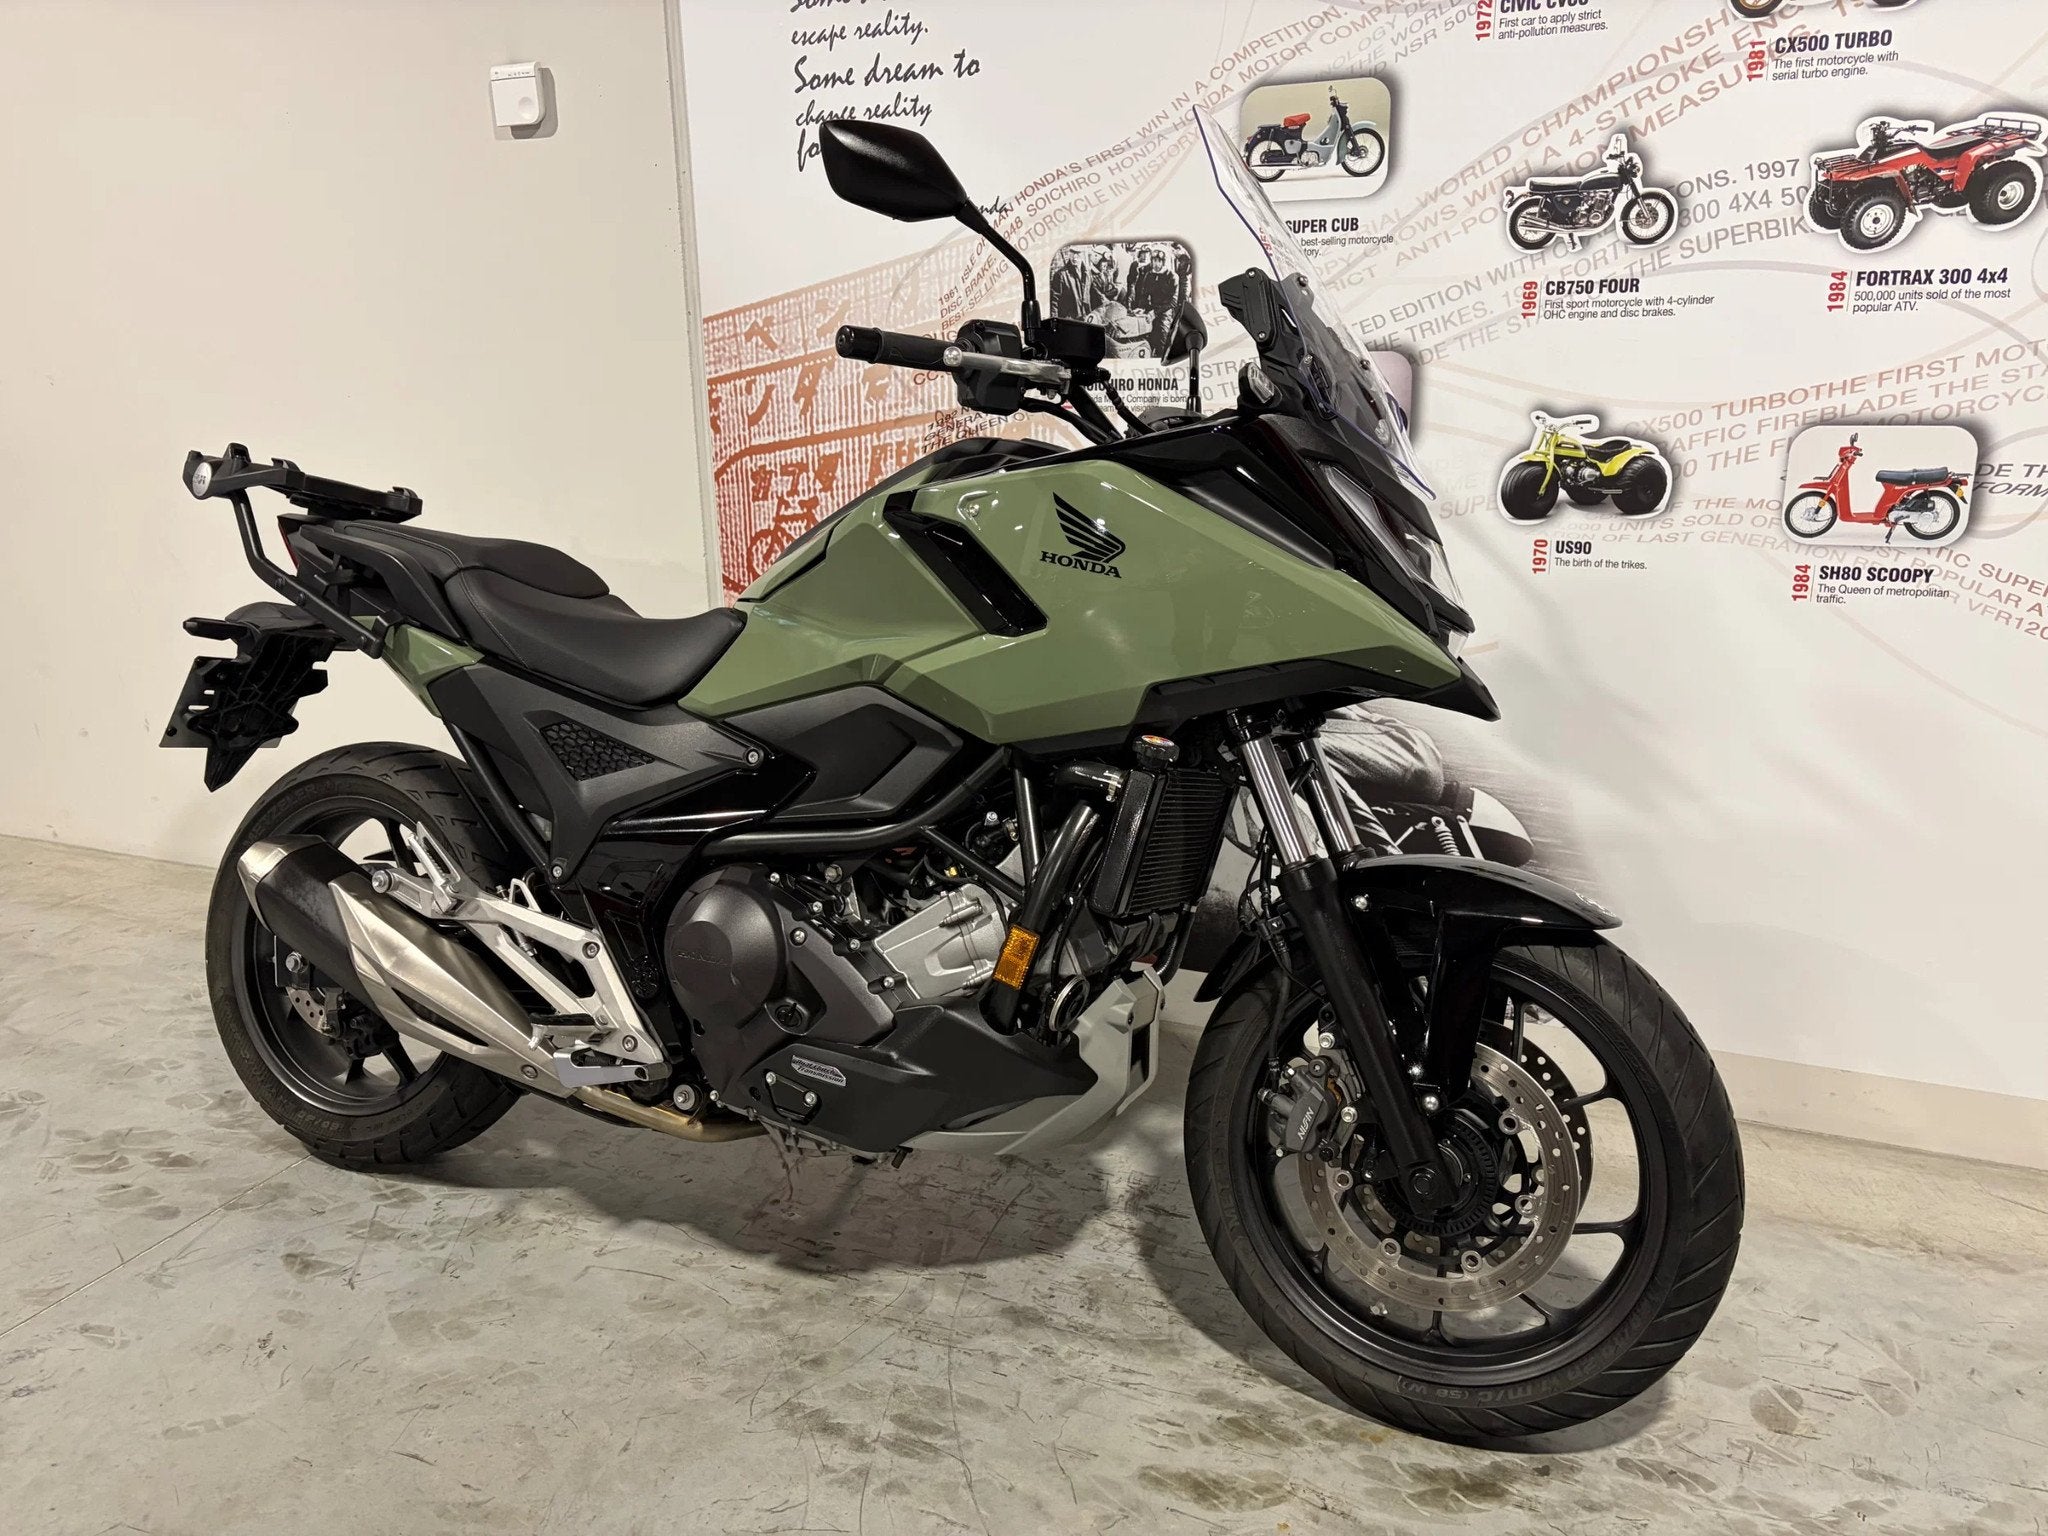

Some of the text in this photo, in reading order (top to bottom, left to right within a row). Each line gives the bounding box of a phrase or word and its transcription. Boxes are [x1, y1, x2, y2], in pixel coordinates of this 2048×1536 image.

[791, 9, 929, 51] escape reality.
[1476, 0, 1492, 41] 1972
[1498, 20, 1608, 40] anti-pollution measures.
[1499, 9, 1602, 28] First car to apply strict
[1394, 28, 1438, 63] NSR
[1775, 29, 1893, 54] CX500 TURBO
[794, 49, 980, 93] Some dream to
[1747, 40, 1766, 81] 1981
[1774, 51, 1899, 69] The first motorcycle with
[1772, 67, 1868, 81] serial turbo engine.
[863, 92, 932, 126] reality
[1463, 158, 1534, 209] WITH
[1542, 145, 1562, 165] A
[1568, 43, 1725, 148] 4-STROKE
[961, 254, 977, 285] ISLE
[1014, 161, 1083, 206] HONDA'S
[1085, 136, 1133, 168] FIRST
[1136, 109, 1170, 139] WIN
[1171, 91, 1190, 111] IN
[1194, 80, 1209, 95] A
[1210, 5, 1348, 80] COMPETITION.
[940, 295, 963, 319] DISC
[1026, 172, 1101, 218] SOICHIRO
[1108, 133, 1169, 176] HONDA
[1238, 42, 1313, 83] MOTOR
[1415, 146, 1512, 209] WORLD
[1744, 158, 1800, 181] 1997
[1108, 178, 1130, 198] IN
[1729, 189, 1773, 213] 4X4
[1331, 217, 1359, 232] CUB
[1301, 234, 1394, 249] best-selling motorcycle
[1389, 275, 1482, 323] EDITION
[1486, 252, 1547, 286] WITH
[1545, 280, 1595, 296] CB750
[1598, 278, 1640, 294] FOUR
[1856, 267, 2008, 287] FORTRAX 300 4x4
[1521, 281, 1538, 320] 1969
[1544, 295, 1715, 311] First sport motorcycle with 4-cylinder
[1827, 271, 1847, 312] 1984
[1853, 288, 2011, 302] 500,000 units sold of the most
[1543, 306, 1676, 321] OHC engine and disc brakes.
[1852, 301, 1918, 315] popular ATV.
[1405, 301, 1495, 343] TRIKES.
[1453, 321, 1500, 352] THE
[1138, 377, 1179, 391] HONDA
[1624, 409, 1703, 436] CX500
[1877, 355, 1965, 388] FIRST
[1126, 394, 1161, 405] Company
[1757, 387, 1918, 435] FIREBLADE
[1928, 373, 1989, 399] THE
[1707, 443, 1760, 471] THE
[1694, 497, 1737, 511] THE
[1682, 513, 1744, 528] SOLD
[1532, 539, 1548, 574] 1970
[1555, 540, 1592, 555] US90
[1602, 533, 1631, 543] OF
[1637, 531, 1695, 543] LAST
[1700, 531, 1847, 563] GENERATION
[1040, 551, 1122, 578] HONDA
[1555, 557, 1648, 570] The birth of the trikes.
[1819, 565, 1935, 584] SH80 SCOOPY
[1792, 564, 1811, 602] 1984
[1817, 583, 1836, 594] The
[1838, 584, 1871, 596] Queen
[1873, 585, 1885, 595] of
[1886, 586, 1950, 600] metropolitan
[1816, 594, 1847, 605] traffic.
